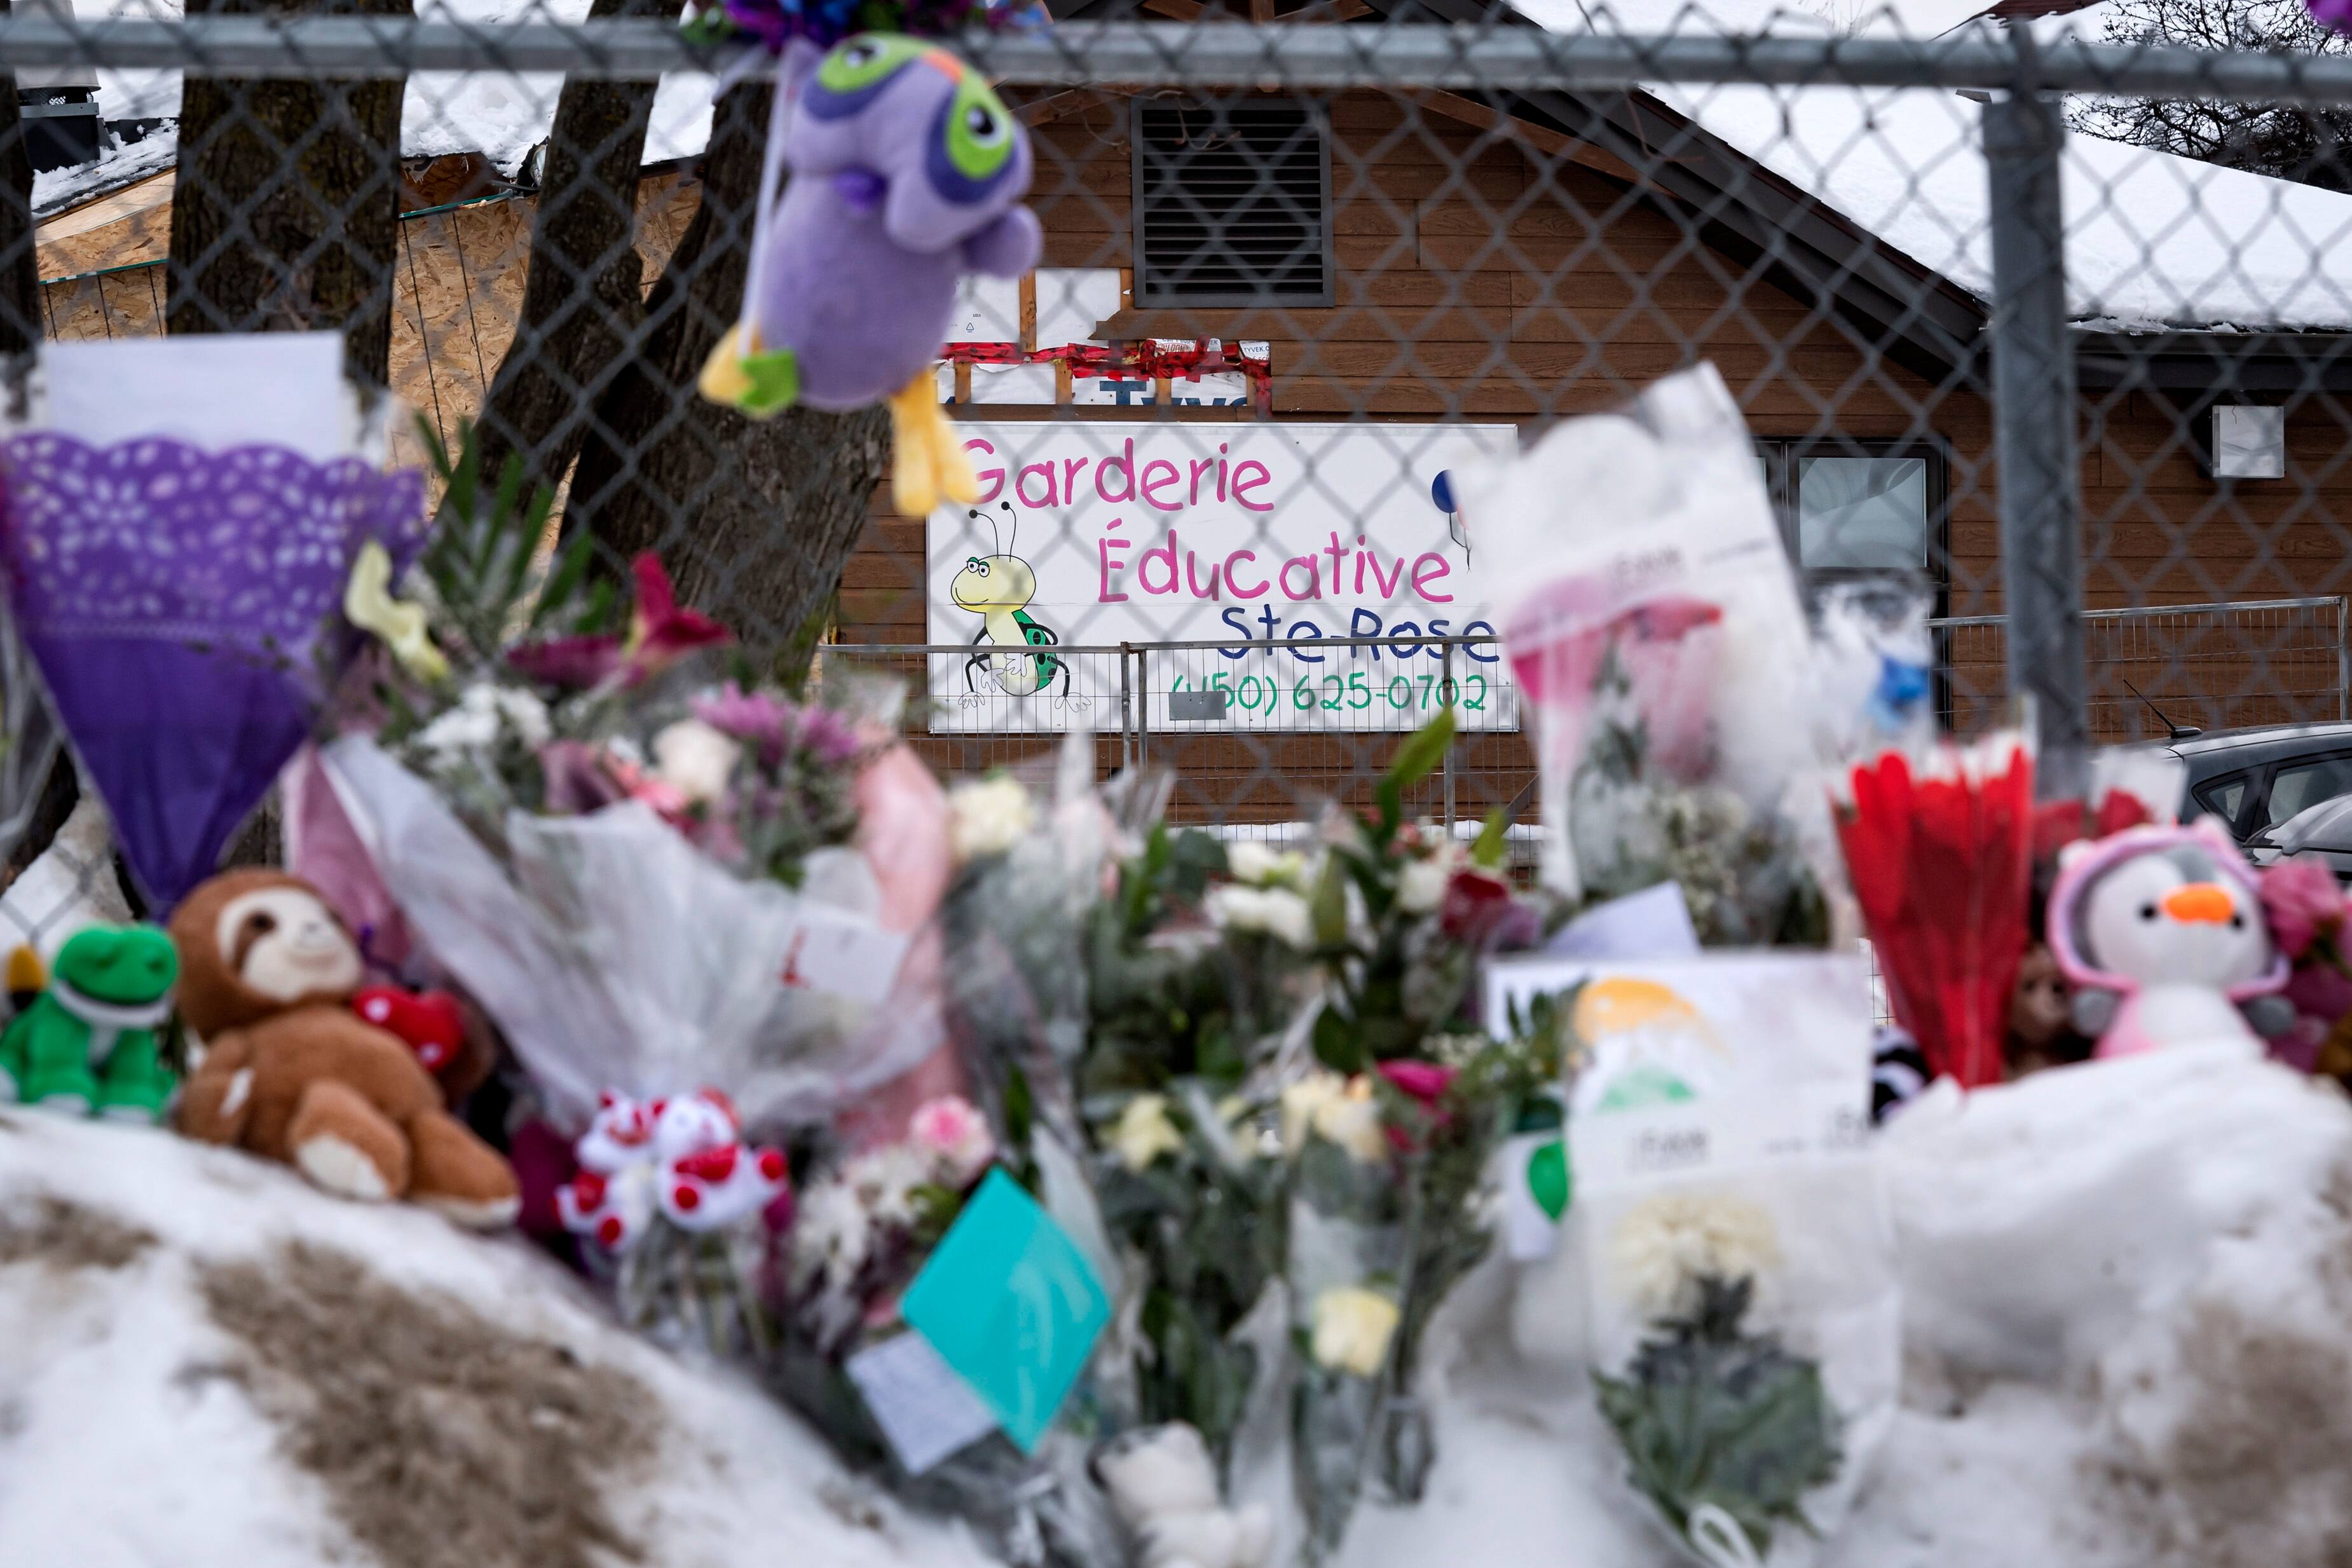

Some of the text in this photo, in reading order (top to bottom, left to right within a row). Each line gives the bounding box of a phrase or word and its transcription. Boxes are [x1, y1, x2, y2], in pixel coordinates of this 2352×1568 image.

[961, 438, 1274, 511] Garderie
[1099, 517, 1454, 603] Éducative
[1293, 672, 1487, 711] 625-0702
